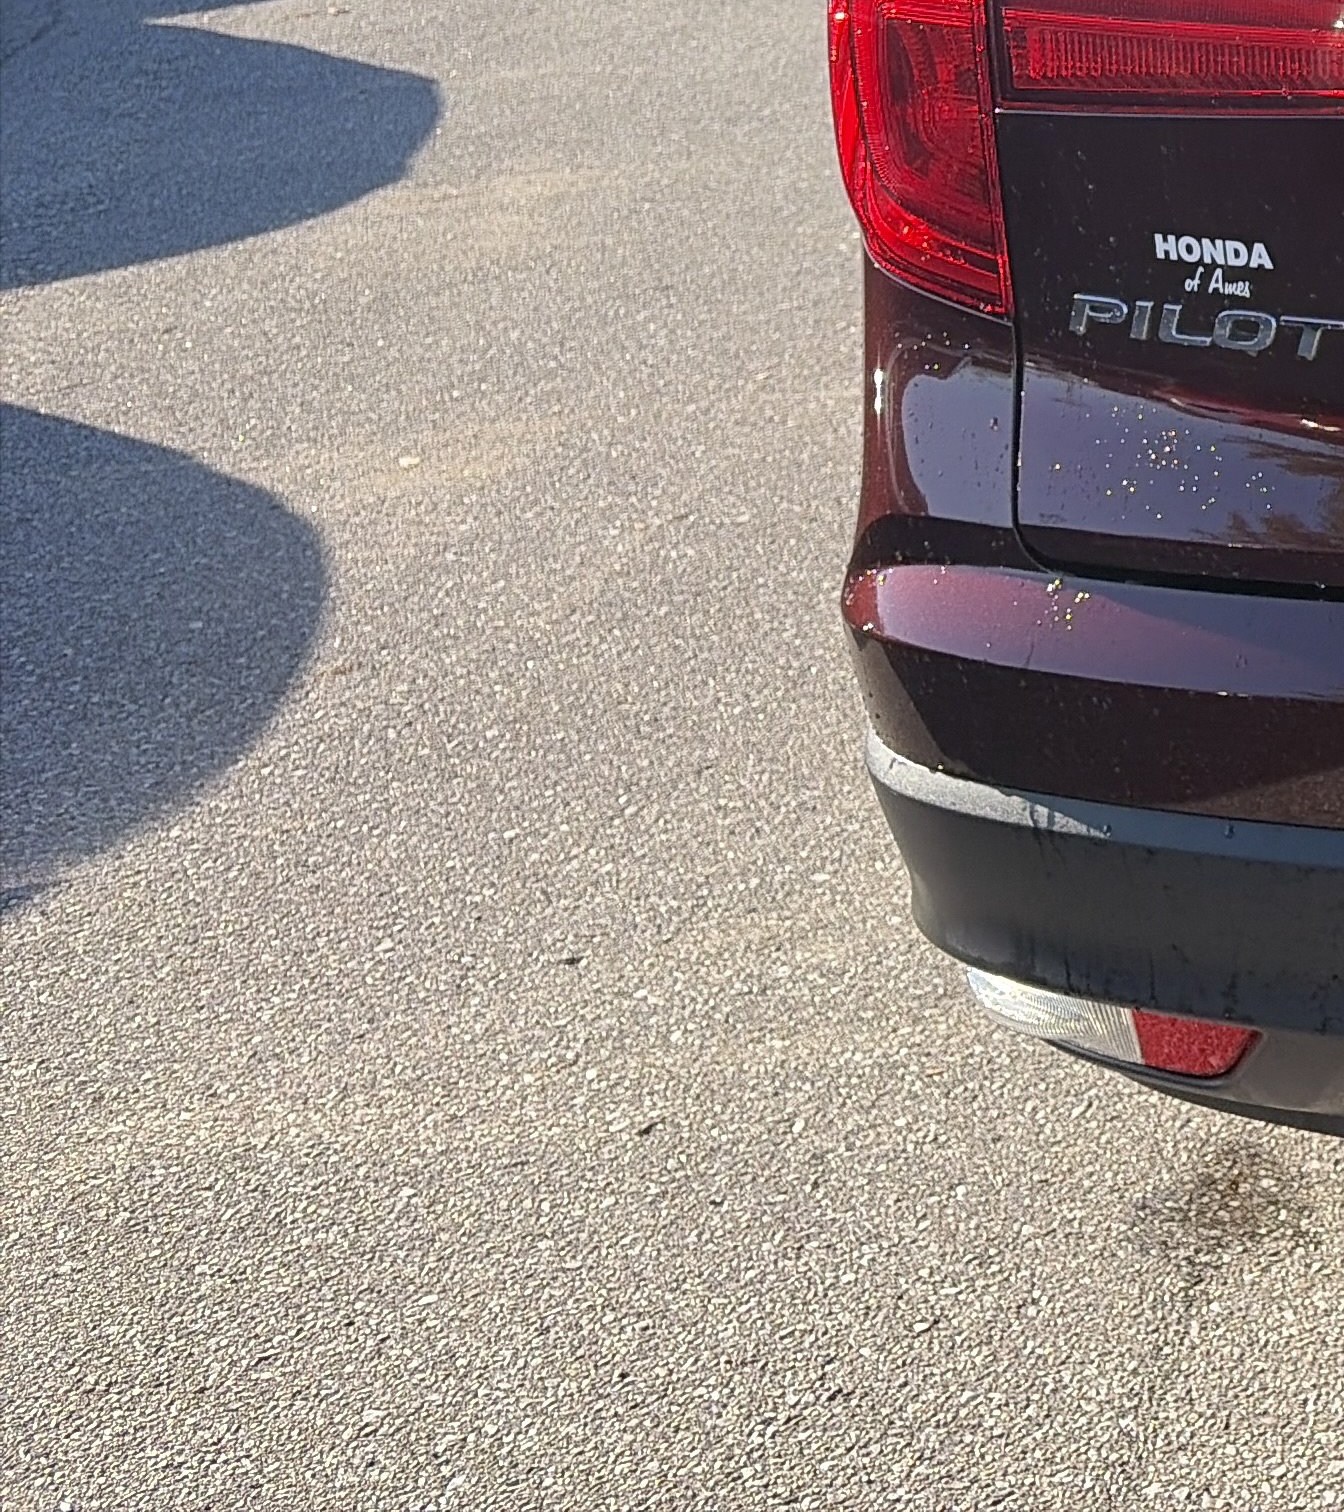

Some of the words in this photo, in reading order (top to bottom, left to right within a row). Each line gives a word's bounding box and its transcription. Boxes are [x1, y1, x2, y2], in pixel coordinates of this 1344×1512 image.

[1154, 233, 1274, 270] HONDA
[1184, 266, 1205, 292] of
[1208, 268, 1251, 298] Ames
